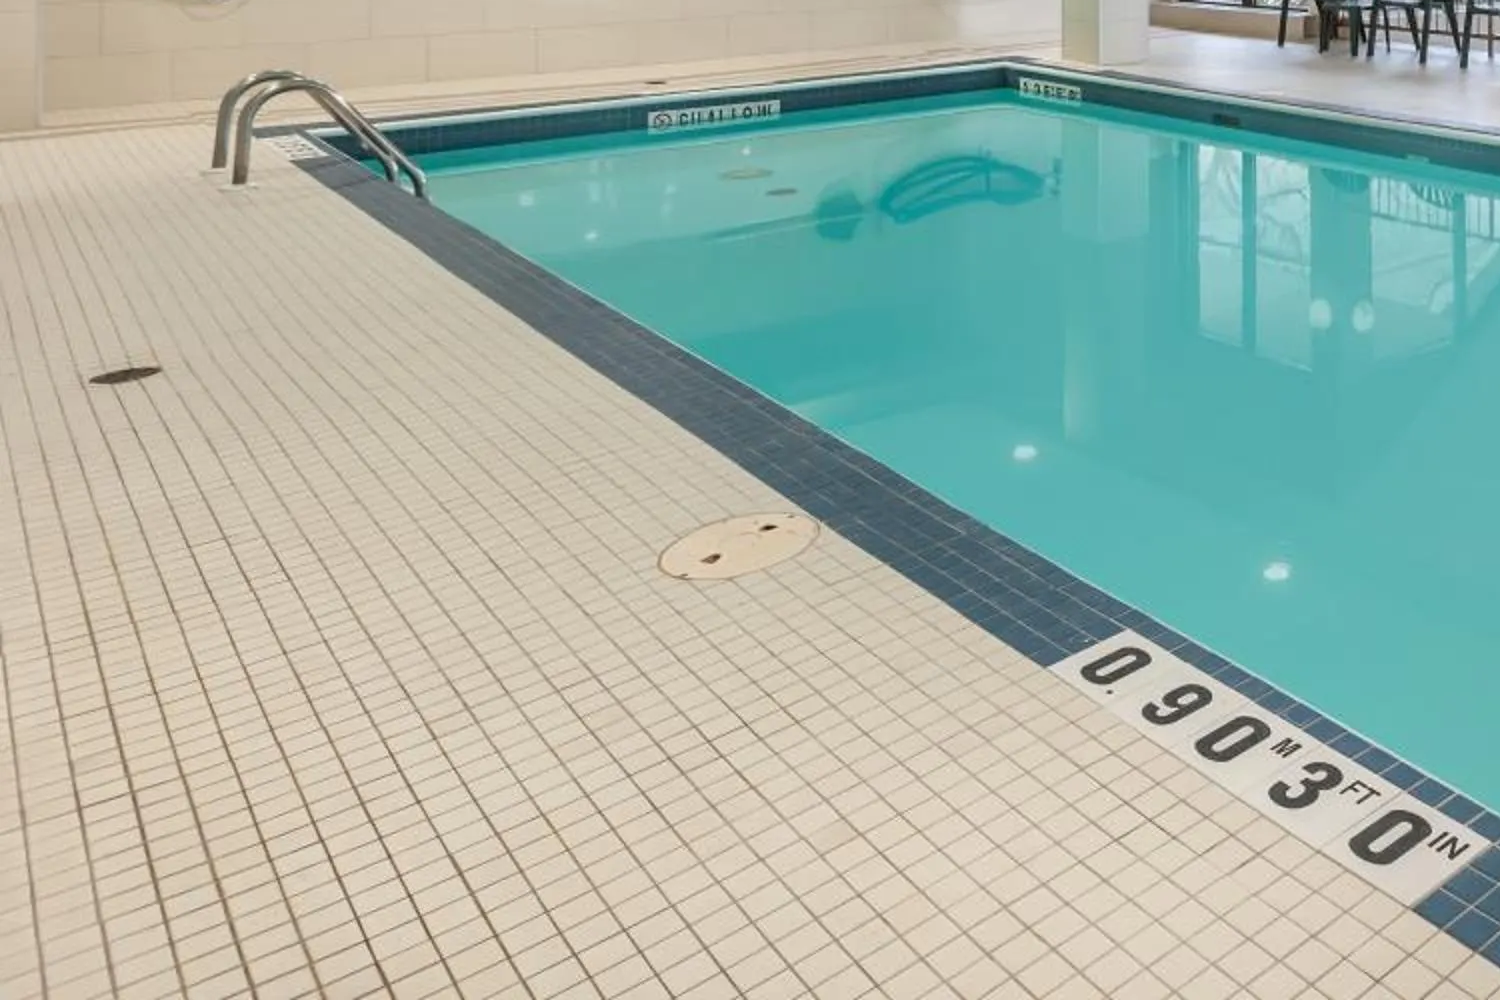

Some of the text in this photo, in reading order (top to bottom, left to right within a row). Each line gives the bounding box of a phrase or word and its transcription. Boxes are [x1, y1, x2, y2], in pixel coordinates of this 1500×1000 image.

[1270, 737, 1303, 759] M
[1268, 762, 1344, 809] 3
[1340, 780, 1382, 806] FT
[1348, 810, 1433, 866] 0
[1428, 831, 1471, 861] IN
